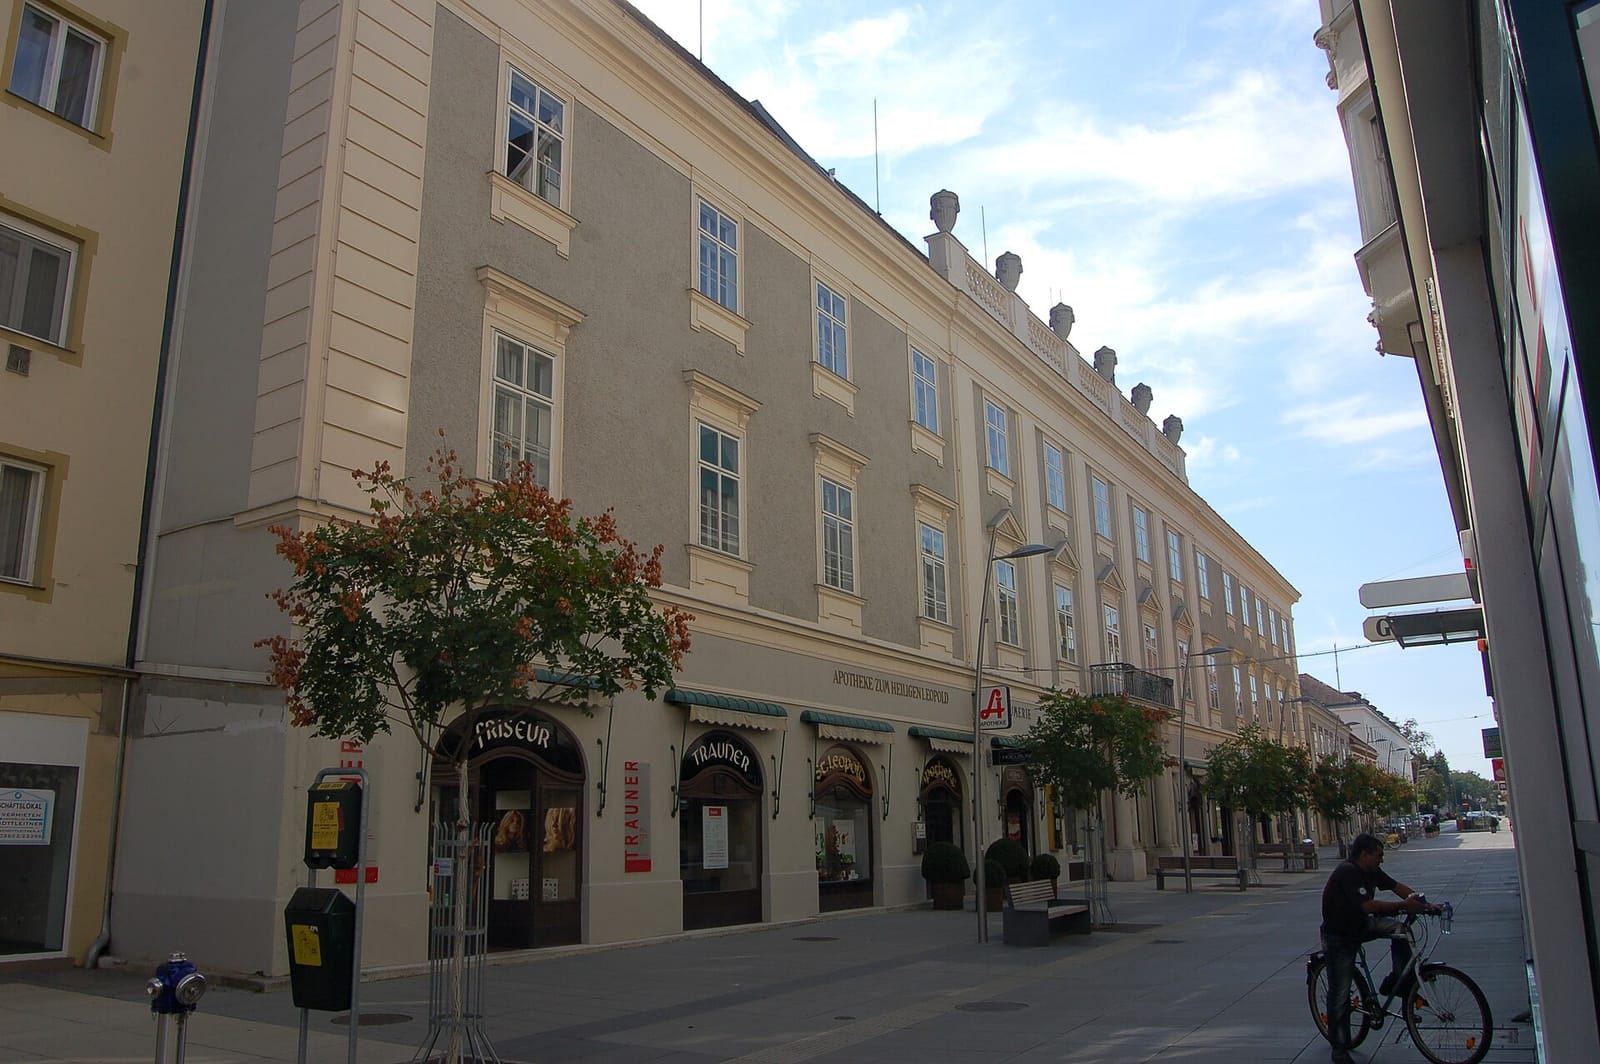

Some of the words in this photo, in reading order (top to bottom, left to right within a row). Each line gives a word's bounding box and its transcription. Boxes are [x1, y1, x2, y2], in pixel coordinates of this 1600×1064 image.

[833, 669, 874, 690] APOTHEKE
[875, 678, 890, 694] ZUM
[891, 681, 920, 699] HEILIGEN
[921, 687, 949, 704] LEOPOLD
[475, 719, 550, 749] FRISEUR
[691, 742, 750, 772] TRAUNER
[625, 761, 639, 860] TRAUNER
